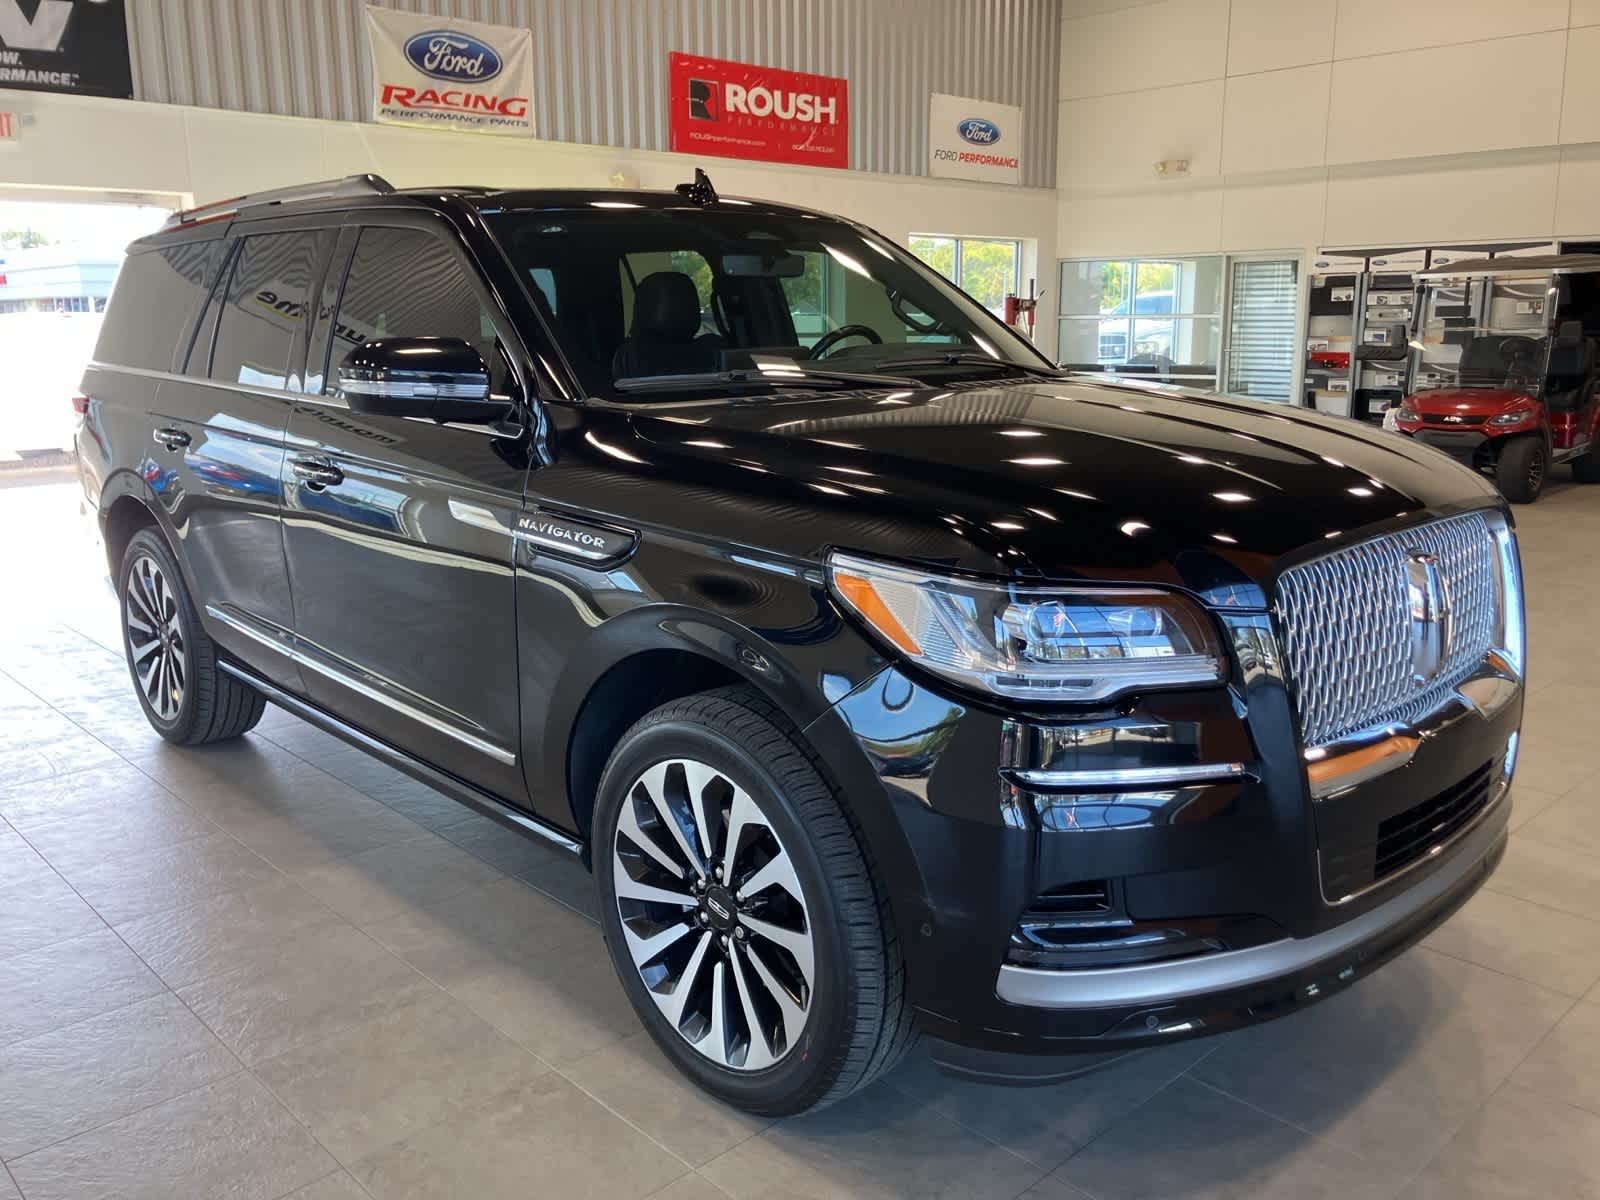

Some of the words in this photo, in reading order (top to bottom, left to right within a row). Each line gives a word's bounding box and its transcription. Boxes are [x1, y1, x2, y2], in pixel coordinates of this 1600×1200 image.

[423, 36, 485, 77] Ford
[380, 83, 529, 118] RACING
[725, 82, 837, 125] ROUSH
[380, 108, 486, 126] PERFORMANCE
[489, 118, 529, 128] PARTS
[965, 121, 993, 142] Ford
[934, 149, 957, 161] FORD
[958, 151, 1019, 169] PERFORMANCE
[518, 518, 606, 549] NAVIGATOR
